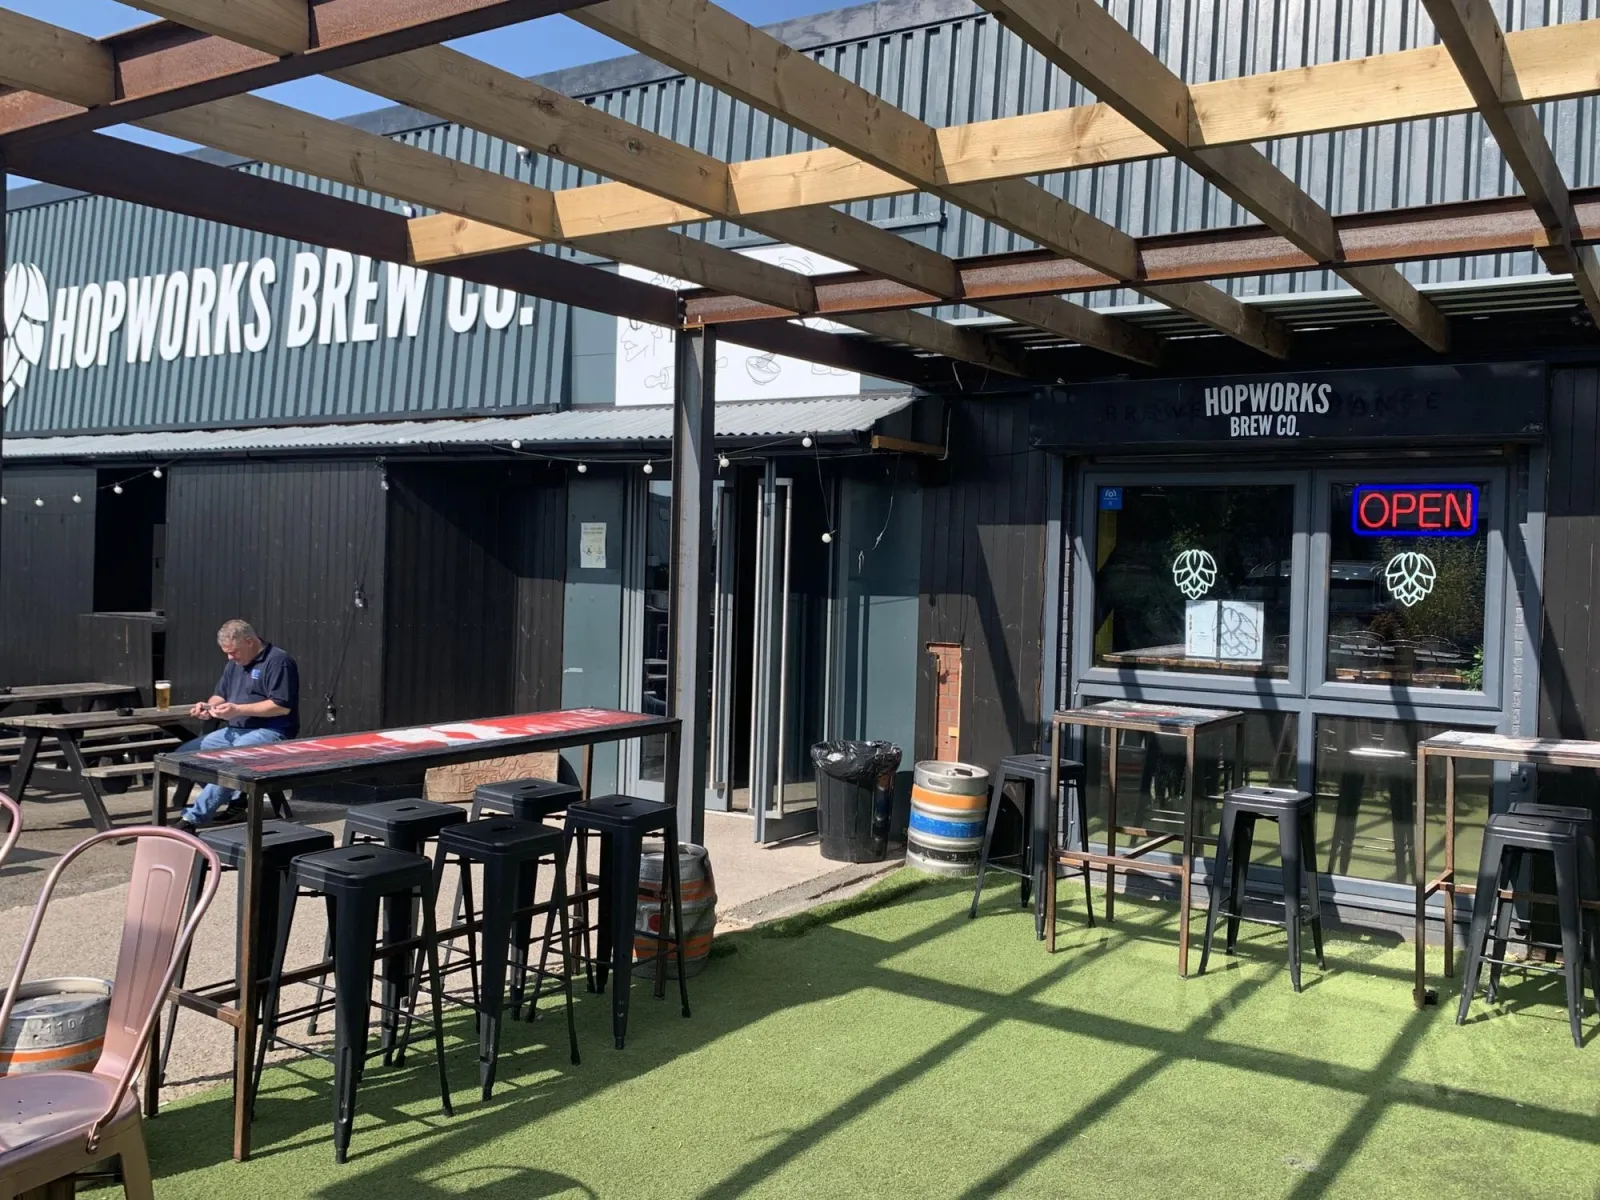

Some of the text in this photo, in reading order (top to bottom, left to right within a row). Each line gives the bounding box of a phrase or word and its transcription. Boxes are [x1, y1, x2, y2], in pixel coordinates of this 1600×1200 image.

[49, 257, 276, 370] HOPWORKS
[287, 248, 428, 348] BREW
[1205, 382, 1332, 416] HOPWORKS
[1230, 414, 1300, 437] BREW CO.
[1360, 492, 1471, 528] OPEN
